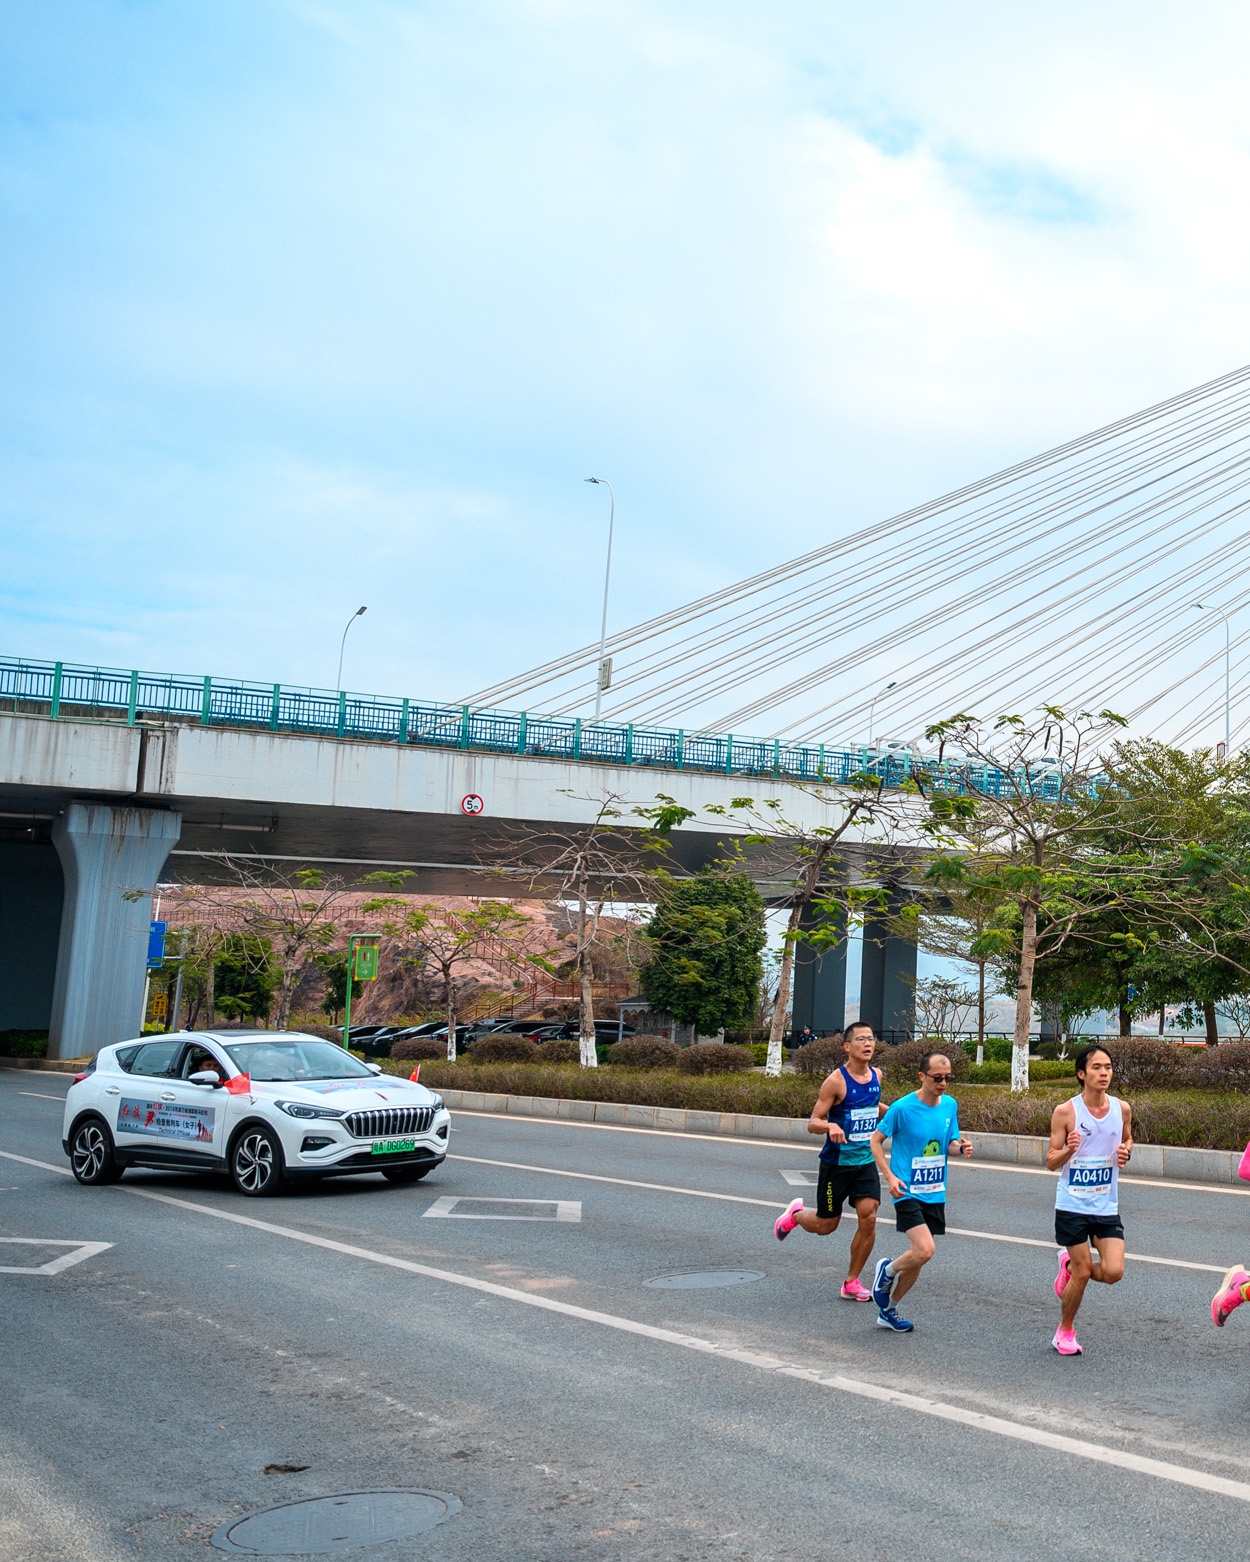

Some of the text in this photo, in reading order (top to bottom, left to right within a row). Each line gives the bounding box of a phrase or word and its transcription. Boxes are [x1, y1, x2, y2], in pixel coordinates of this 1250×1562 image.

[121, 1104, 141, 1120] 红旗
[159, 1127, 175, 1135] Technical
[853, 1118, 877, 1131] A1321
[914, 1168, 942, 1181] A1211
[1072, 1169, 1110, 1183] A0410
